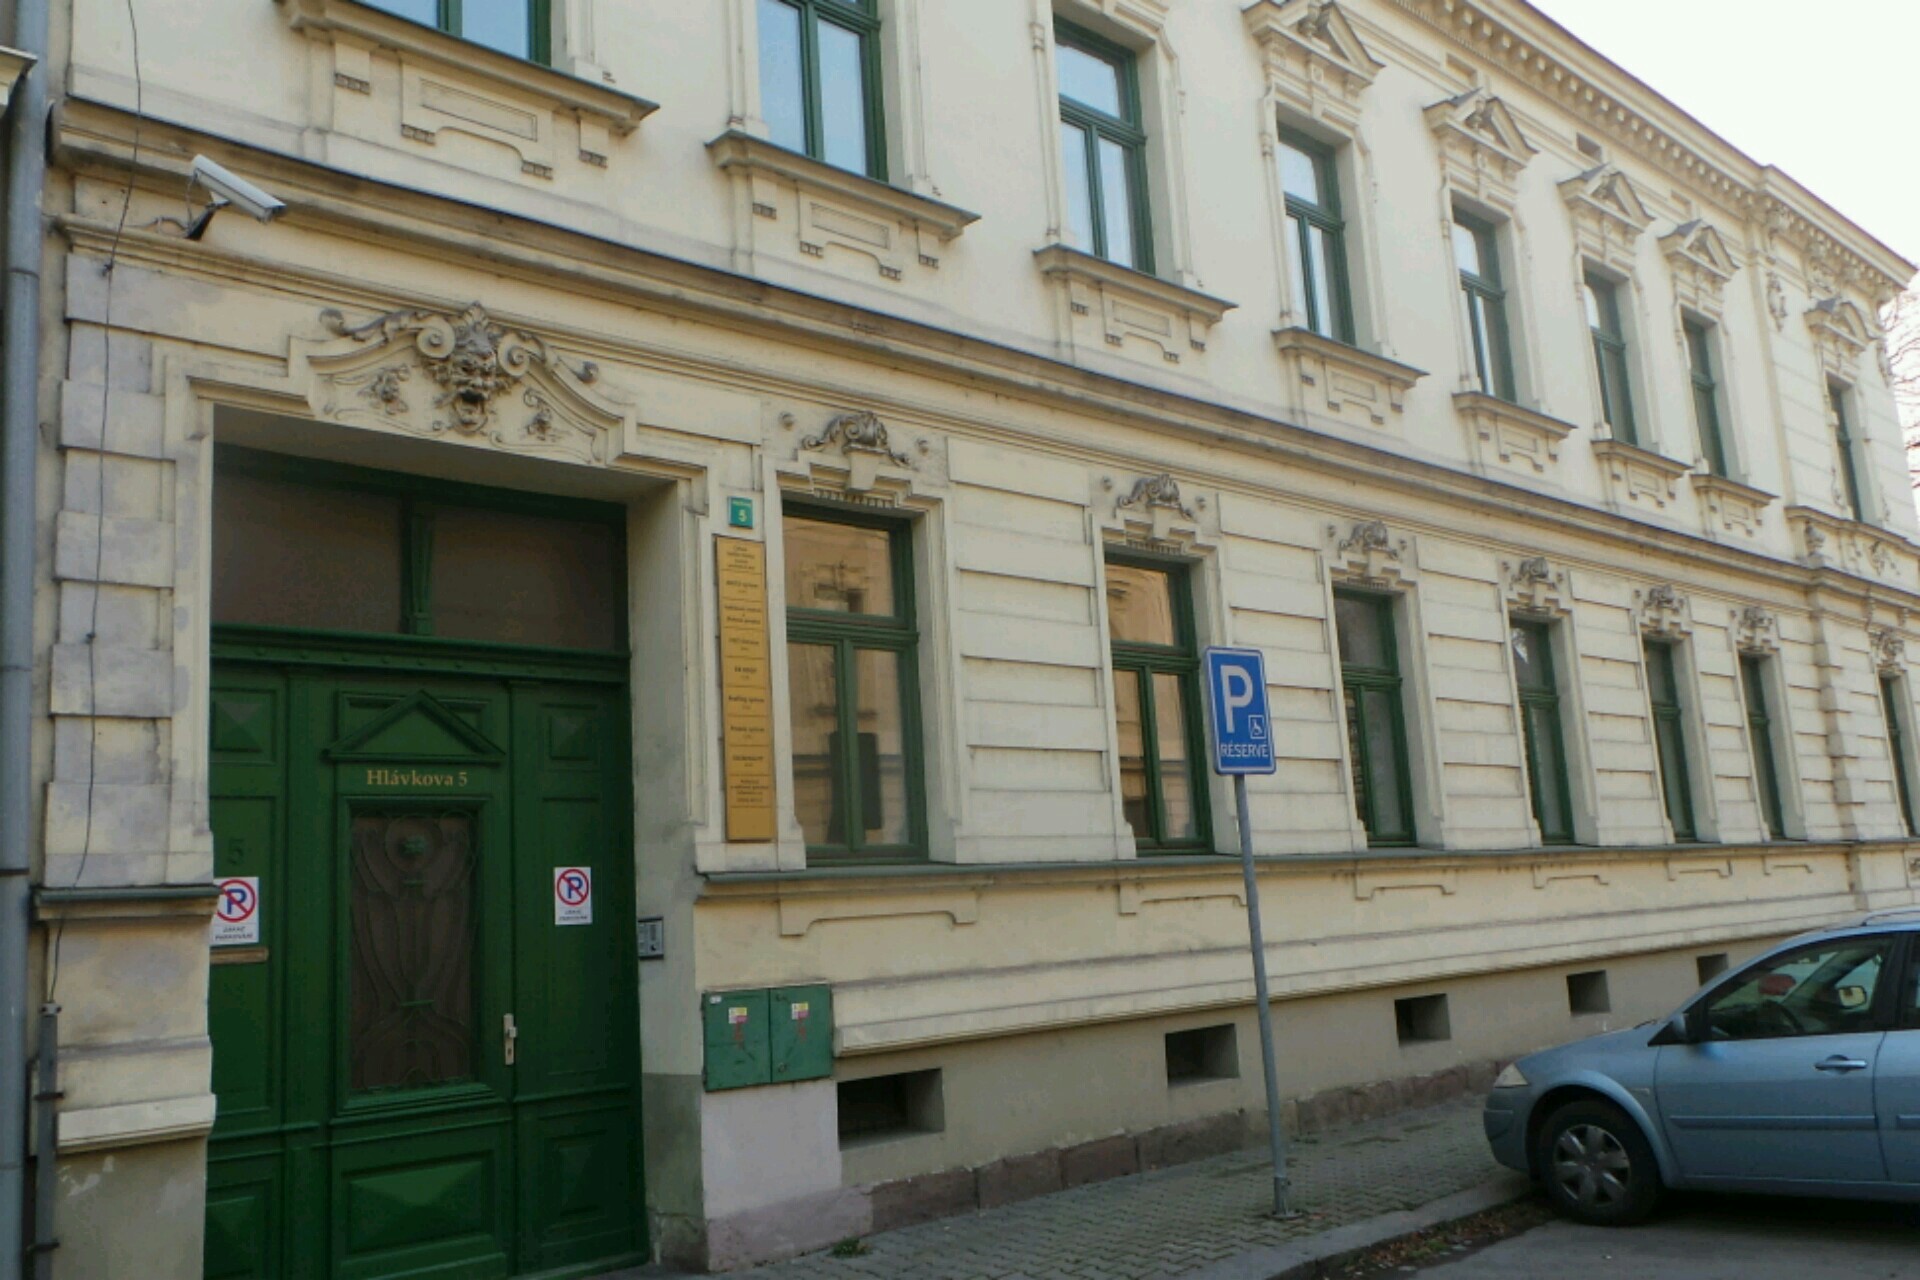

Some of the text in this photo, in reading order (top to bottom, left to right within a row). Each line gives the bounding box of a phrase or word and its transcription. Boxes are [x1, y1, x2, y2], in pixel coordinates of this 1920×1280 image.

[738, 509, 748, 522] 5
[1220, 664, 1253, 734] P
[367, 769, 468, 787] Hlávkova 5
[567, 876, 583, 899] P
[226, 888, 247, 915] P
